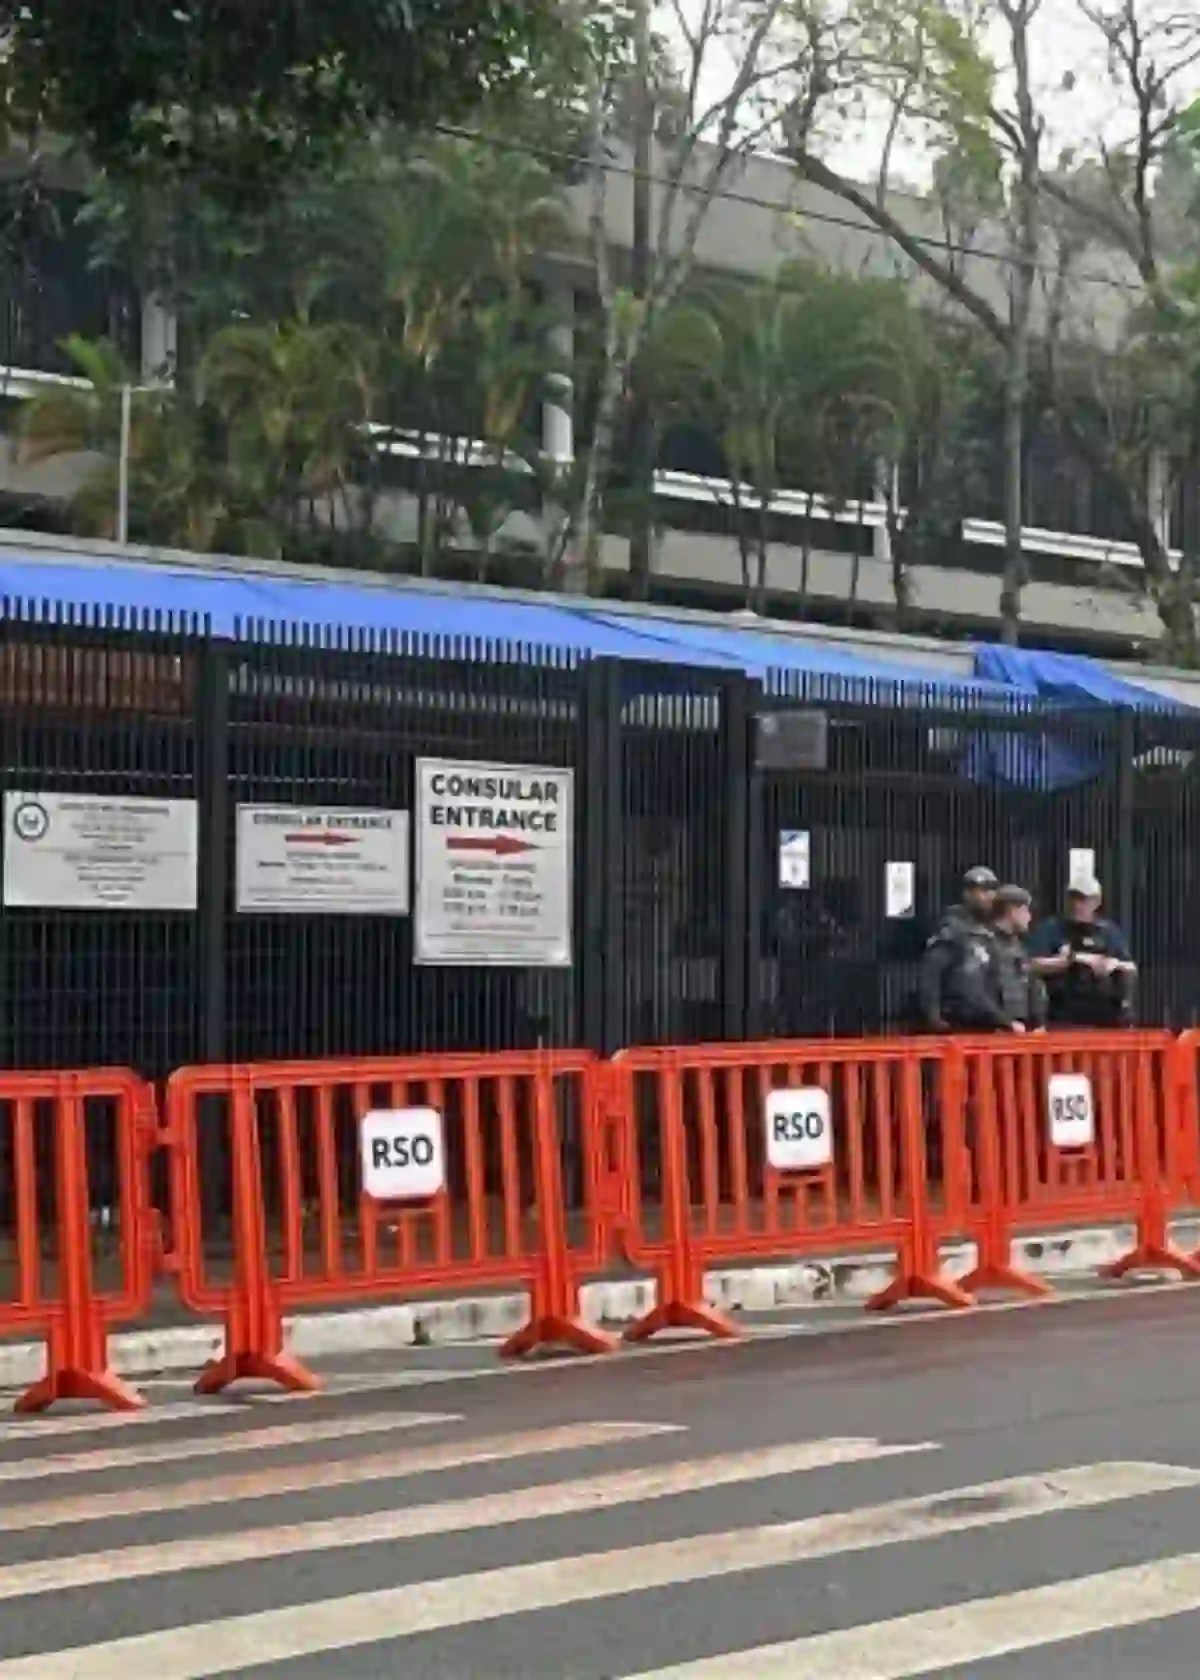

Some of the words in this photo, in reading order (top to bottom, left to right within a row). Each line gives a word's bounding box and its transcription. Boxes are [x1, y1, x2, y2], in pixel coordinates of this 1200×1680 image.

[431, 774, 559, 803] CONSULAR
[430, 805, 557, 832] ENTRANCE
[773, 1111, 824, 1142] RSO
[371, 1135, 434, 1169] RSO
